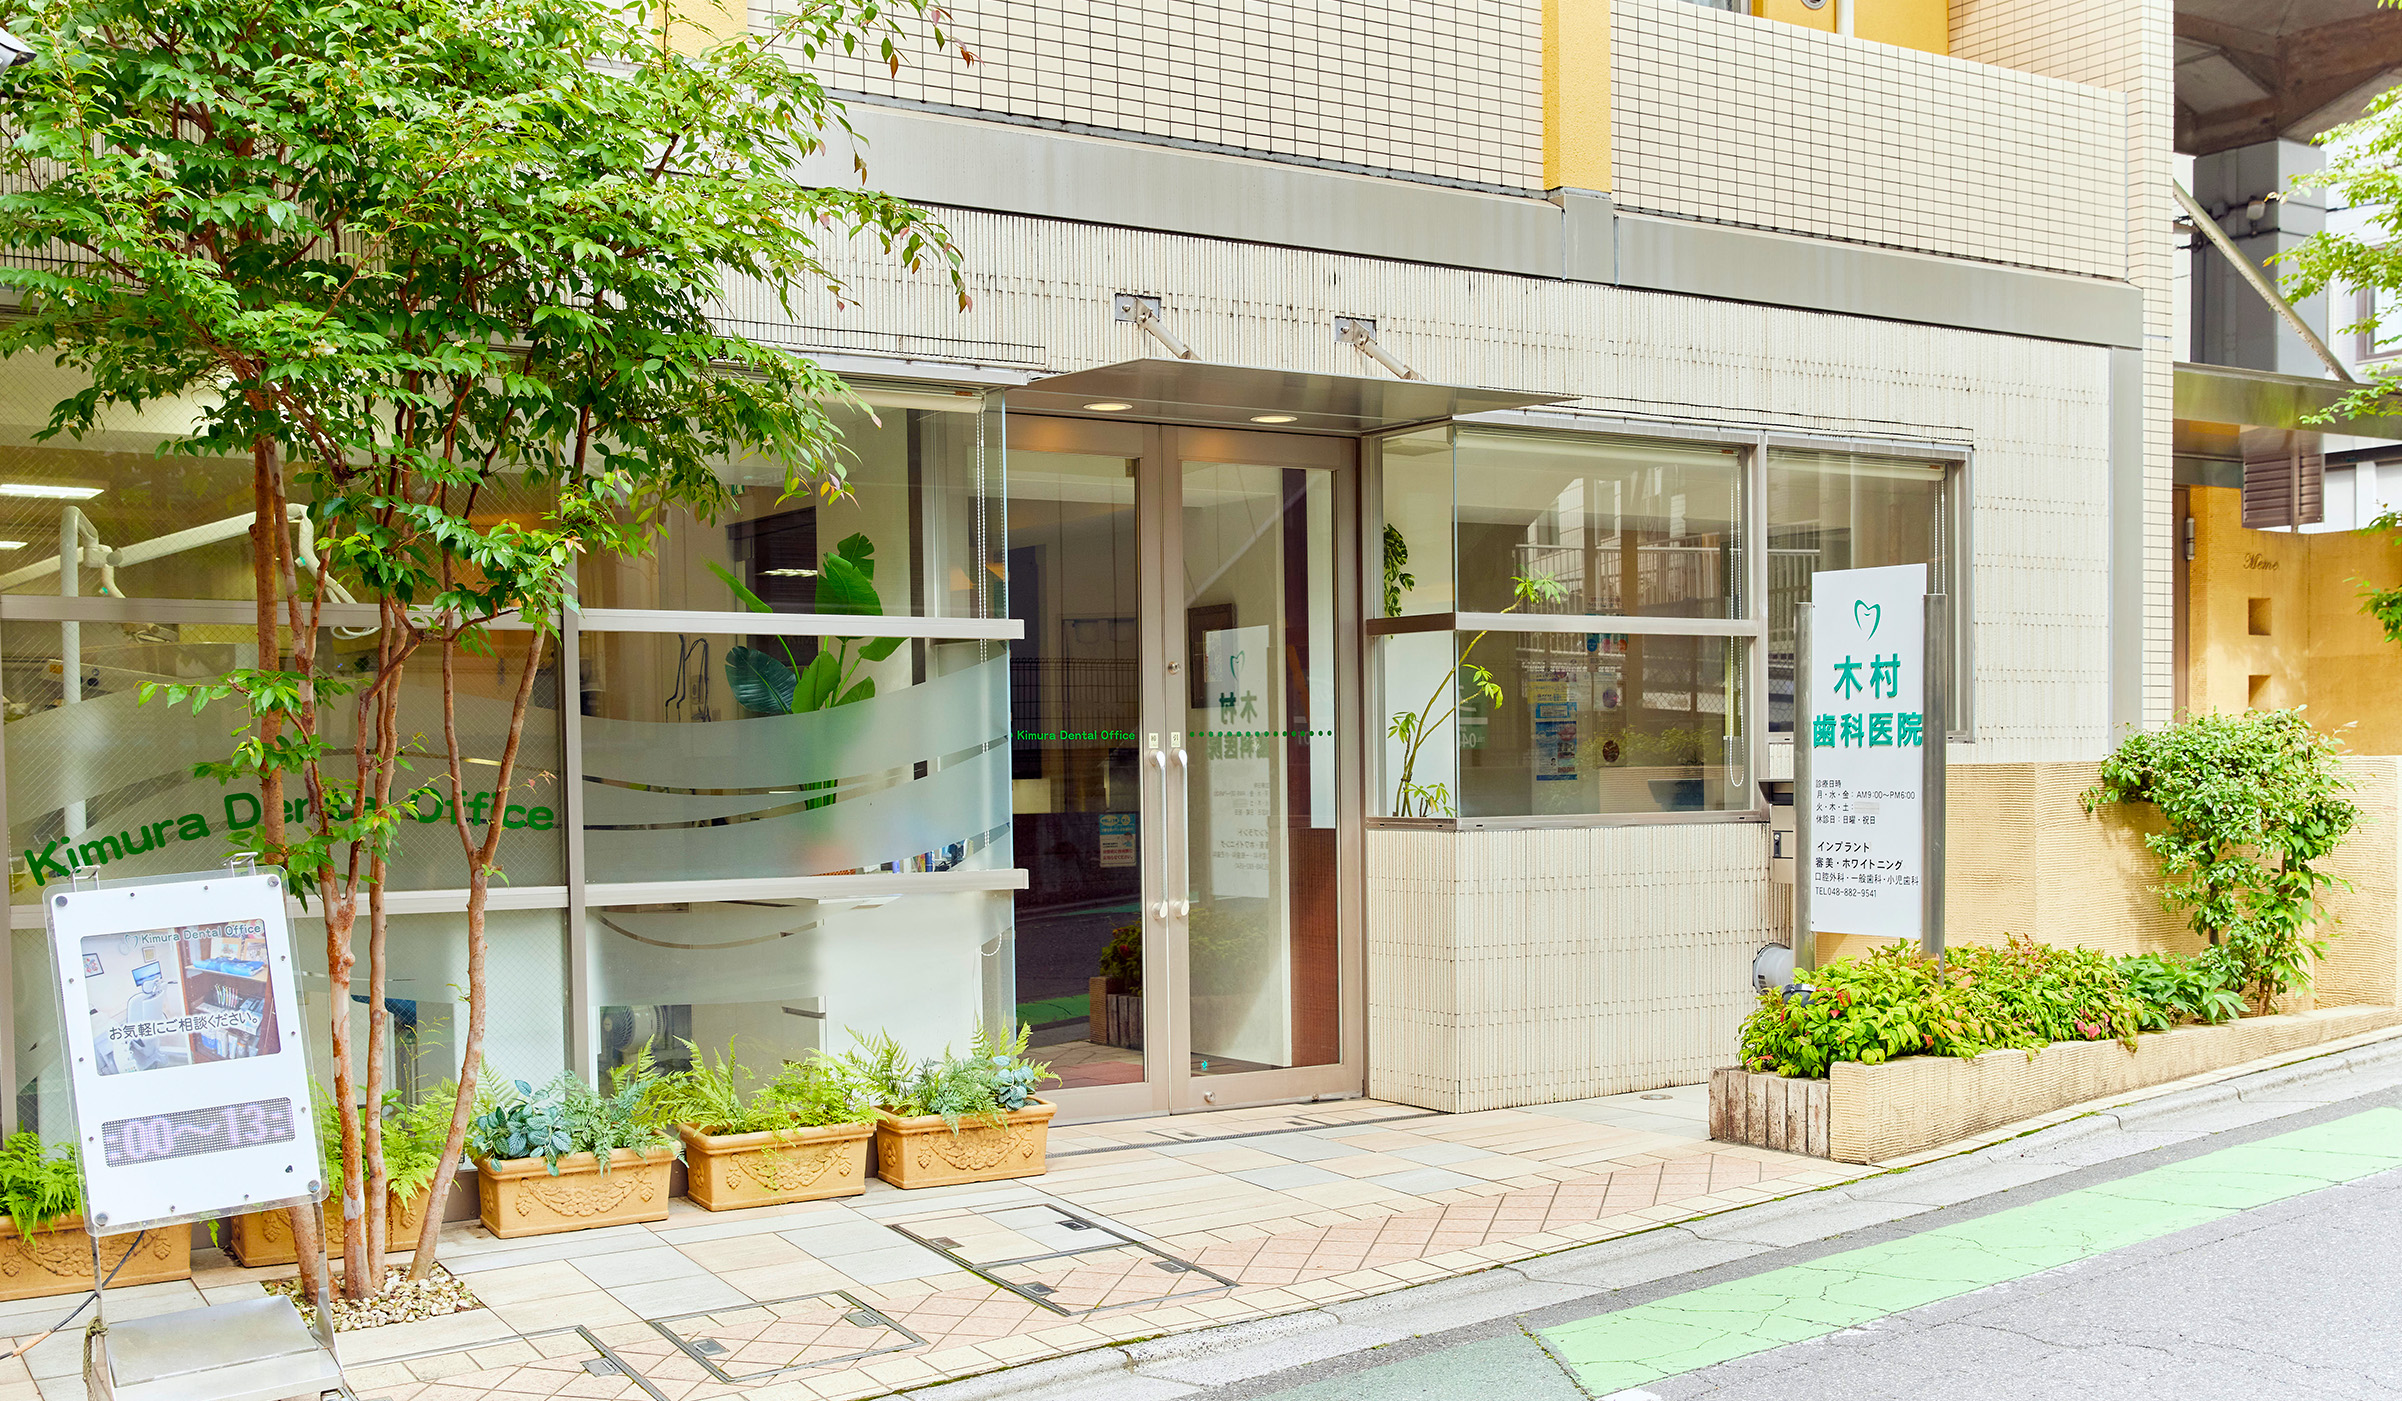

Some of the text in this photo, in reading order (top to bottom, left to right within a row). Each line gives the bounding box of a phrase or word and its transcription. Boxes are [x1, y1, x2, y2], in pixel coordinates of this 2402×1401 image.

[1833, 653, 1900, 700] 木村
[1017, 730, 1136, 740] Kimura Dental Office
[1813, 712, 1923, 748] 歯科医院
[1815, 779, 1842, 788] 診療日時
[24, 813, 211, 887] Kimura
[1817, 840, 1870, 853] インプラント
[1815, 857, 1904, 871] 審美・ホワイトニング
[1815, 886, 1877, 898] TEL048-882-9541
[141, 923, 261, 944] Kimura Dental Office
[108, 1011, 259, 1041] お気軽にご相談ください。
